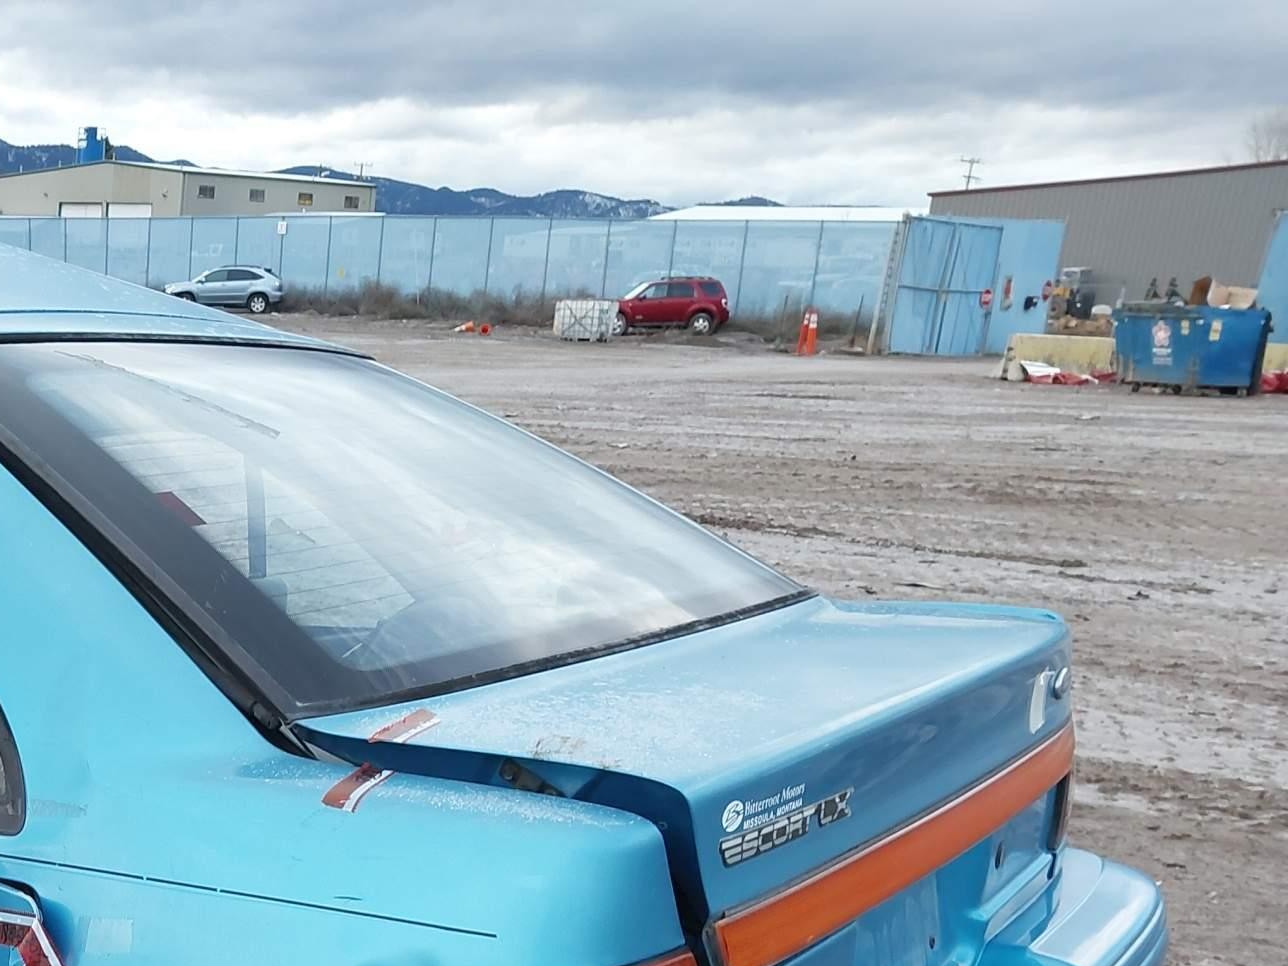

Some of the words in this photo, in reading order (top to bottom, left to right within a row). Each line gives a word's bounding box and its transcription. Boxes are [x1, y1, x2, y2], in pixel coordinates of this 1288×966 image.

[744, 811, 775, 830] MISSOULA,
[776, 797, 803, 816] MONTANA
[745, 792, 780, 812] Bitterroot
[781, 783, 806, 802] Motors
[720, 807, 816, 866] ESCORT
[819, 790, 853, 826] LX
